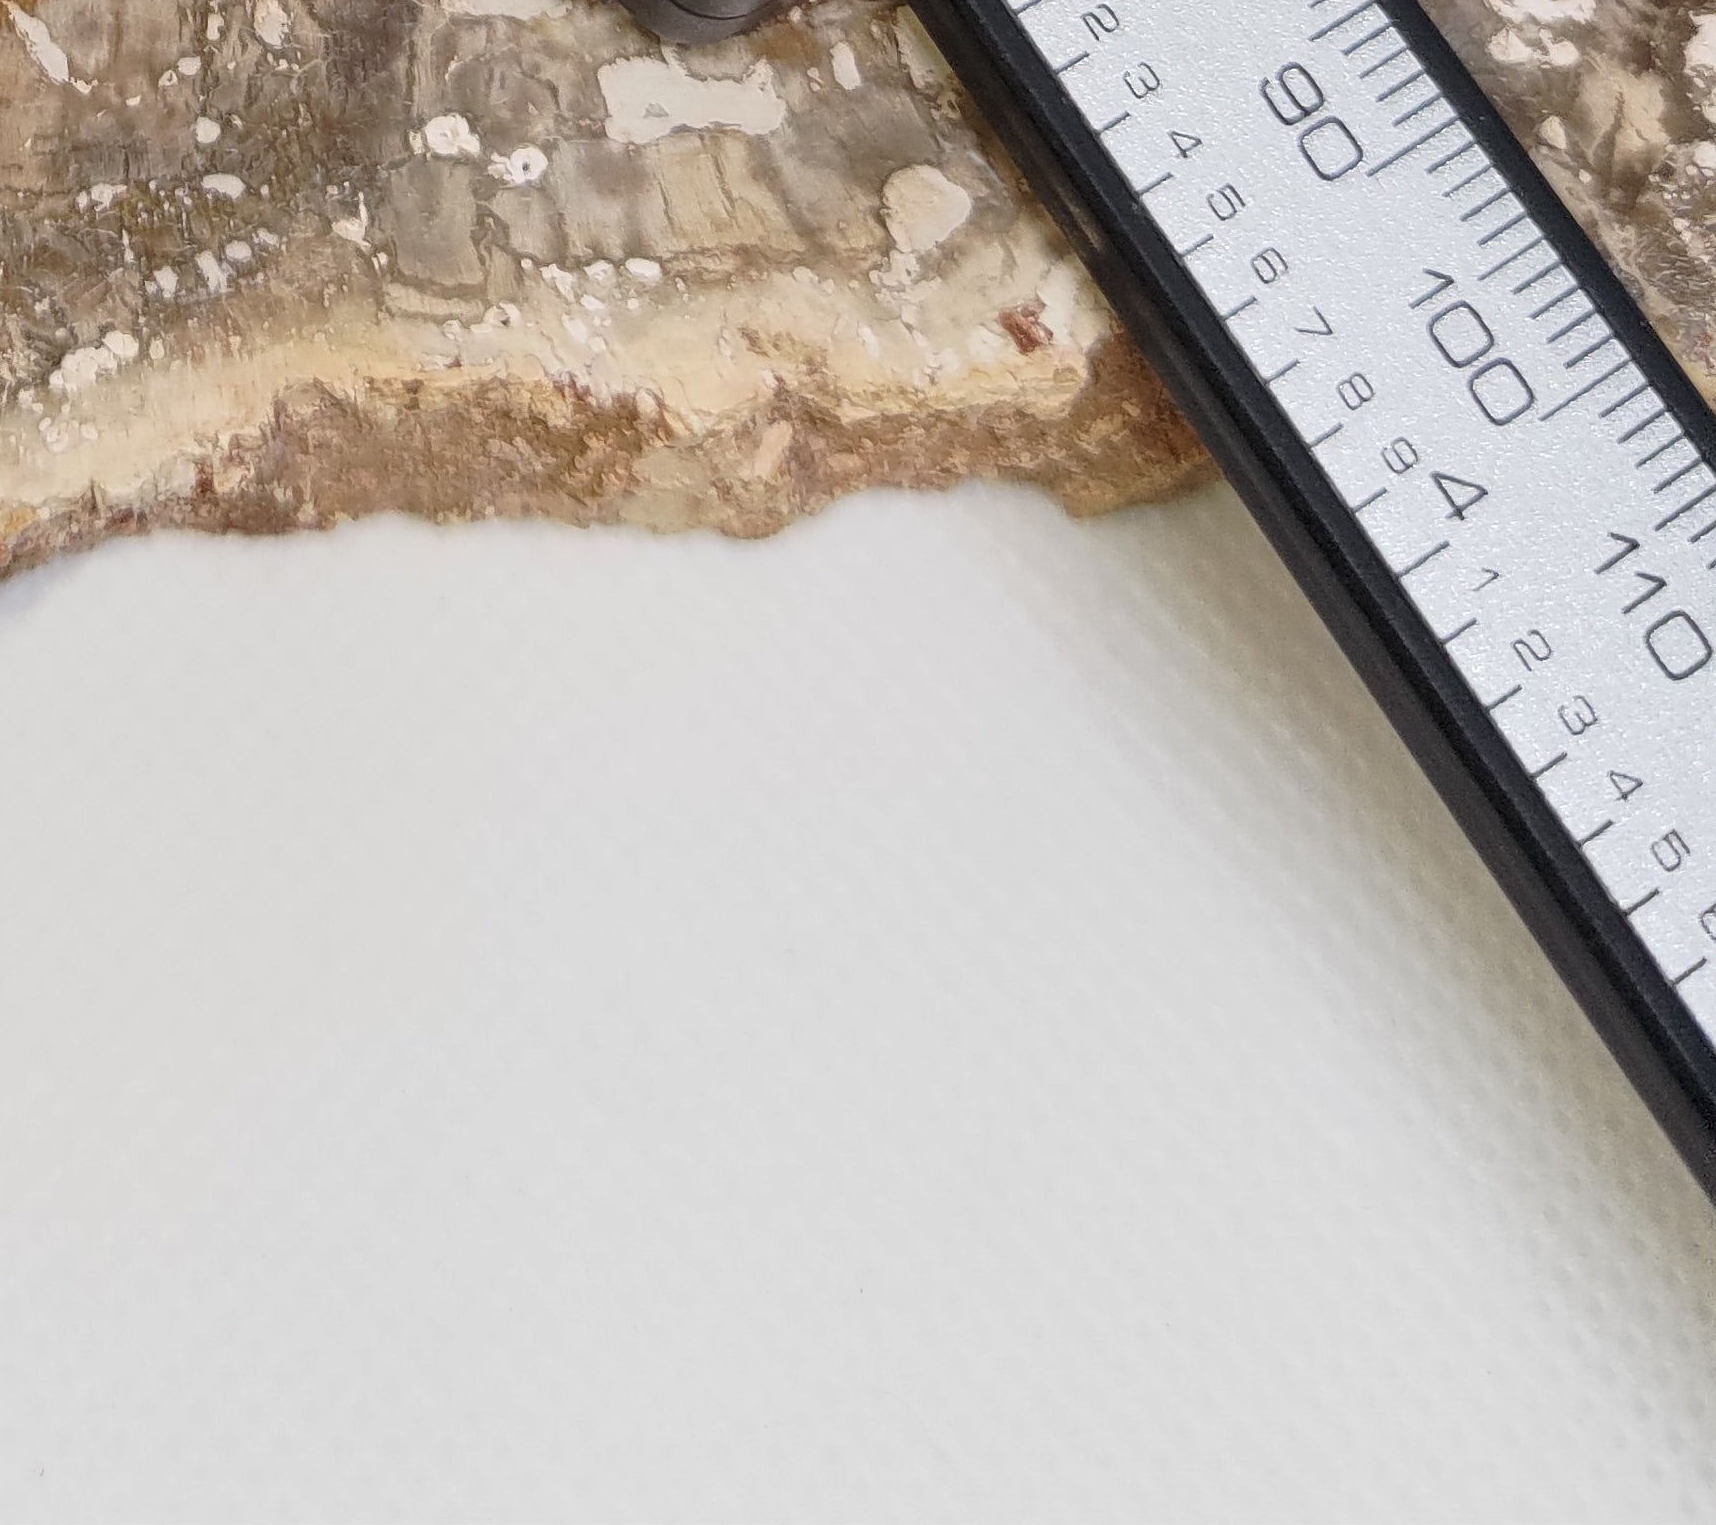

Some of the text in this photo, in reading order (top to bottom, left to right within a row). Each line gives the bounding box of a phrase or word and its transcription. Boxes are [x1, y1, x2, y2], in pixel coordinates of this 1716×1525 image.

[1080, 3, 1121, 41] 2
[1122, 61, 1161, 99] 3
[1167, 130, 1203, 159] 4
[1205, 182, 1246, 221] 5
[1250, 247, 1289, 285] 6
[1294, 306, 1334, 337] 7
[1336, 372, 1374, 411] 8
[1380, 437, 1419, 475] 9
[1431, 471, 1489, 520] 4
[1472, 567, 1500, 592] 1
[1512, 629, 1553, 672] 2
[1557, 695, 1598, 736] 3
[1608, 769, 1644, 801] 4
[1650, 829, 1691, 872] 5
[1259, 61, 1364, 181] 90
[1408, 267, 1535, 426] 100
[1595, 532, 1713, 681] 110
